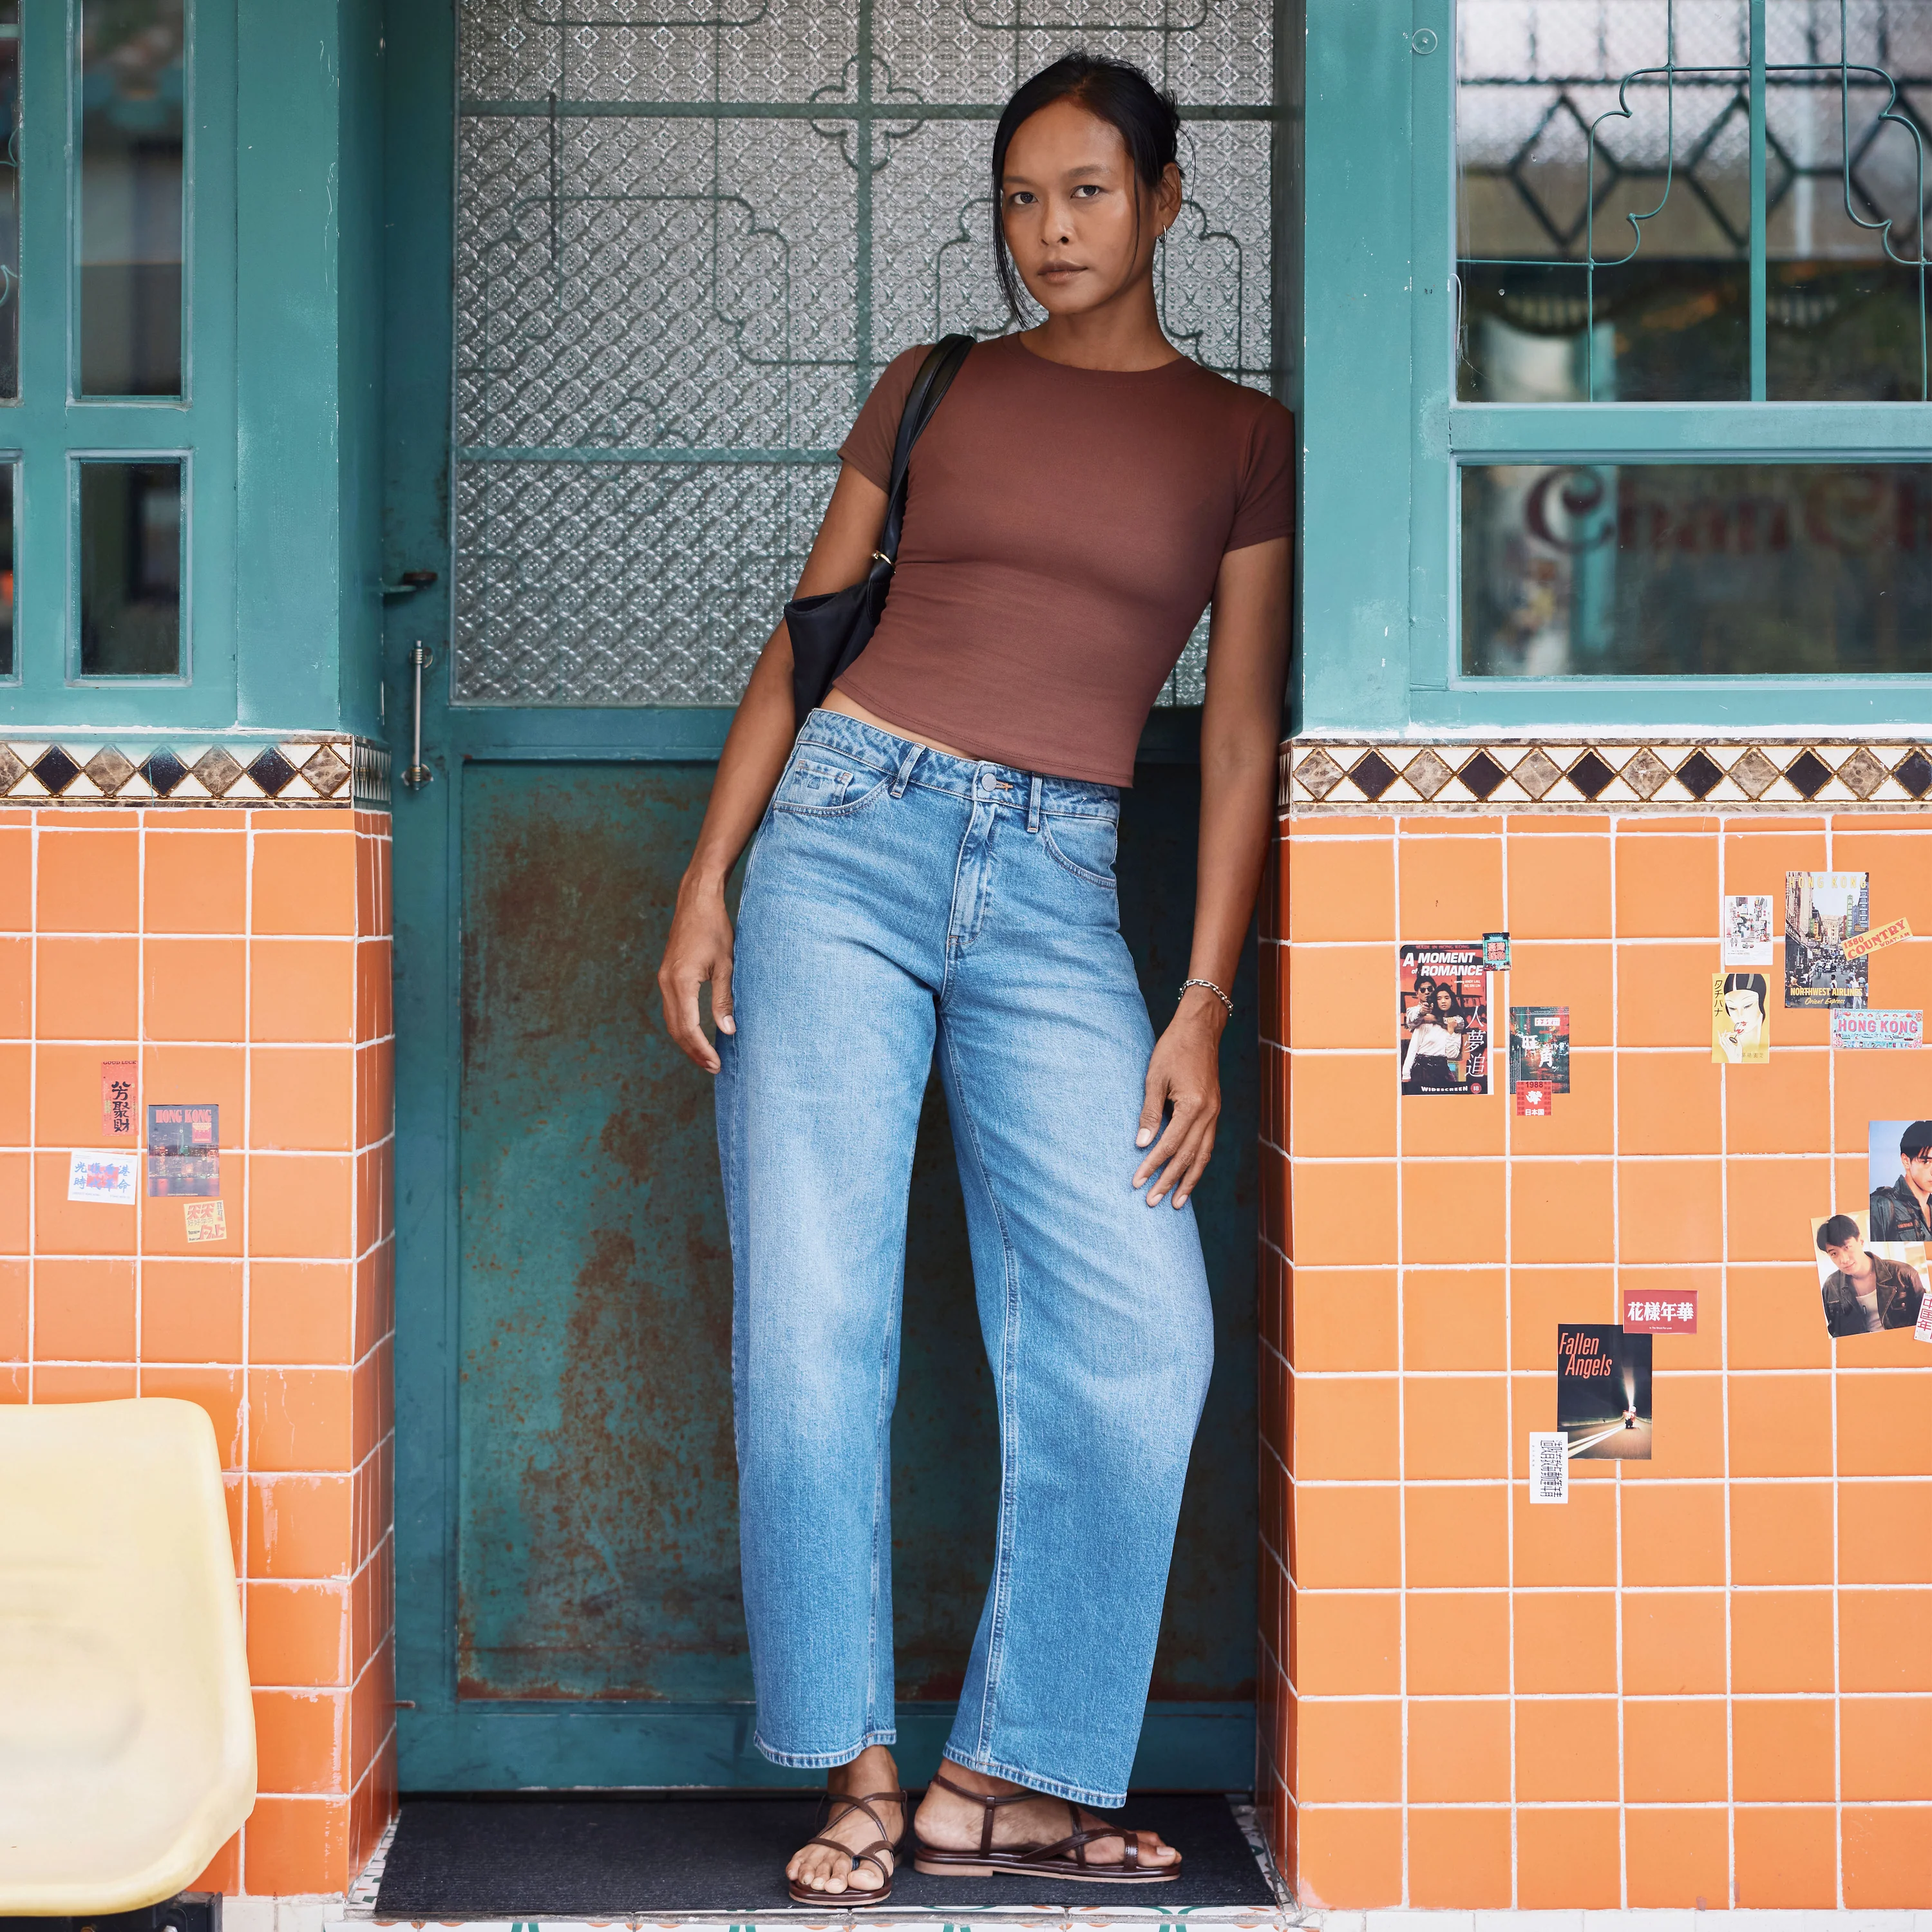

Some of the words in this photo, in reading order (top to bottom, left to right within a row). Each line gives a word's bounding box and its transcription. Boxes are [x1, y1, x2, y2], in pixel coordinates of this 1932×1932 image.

[1789, 876, 1824, 888] HONG
[1832, 876, 1866, 888] KONG
[1843, 936, 1864, 949] 1380
[1848, 919, 1906, 959] COUNTRY
[1403, 952, 1414, 967] A
[1417, 952, 1475, 963] MOMENT
[1421, 965, 1483, 976] ROMANCE
[1714, 980, 1723, 1017] タチバナ
[1790, 987, 1831, 996] NORTHWEST
[1832, 988, 1862, 996] AIRLINES
[1837, 1019, 1877, 1032] HONG
[1880, 1020, 1918, 1033] KONG
[156, 1110, 182, 1123] HONG
[184, 1109, 212, 1123] KONG
[1627, 1302, 1694, 1322] 花樣年華
[1558, 1332, 1600, 1355] Fallen
[1565, 1354, 1613, 1379] Angels
